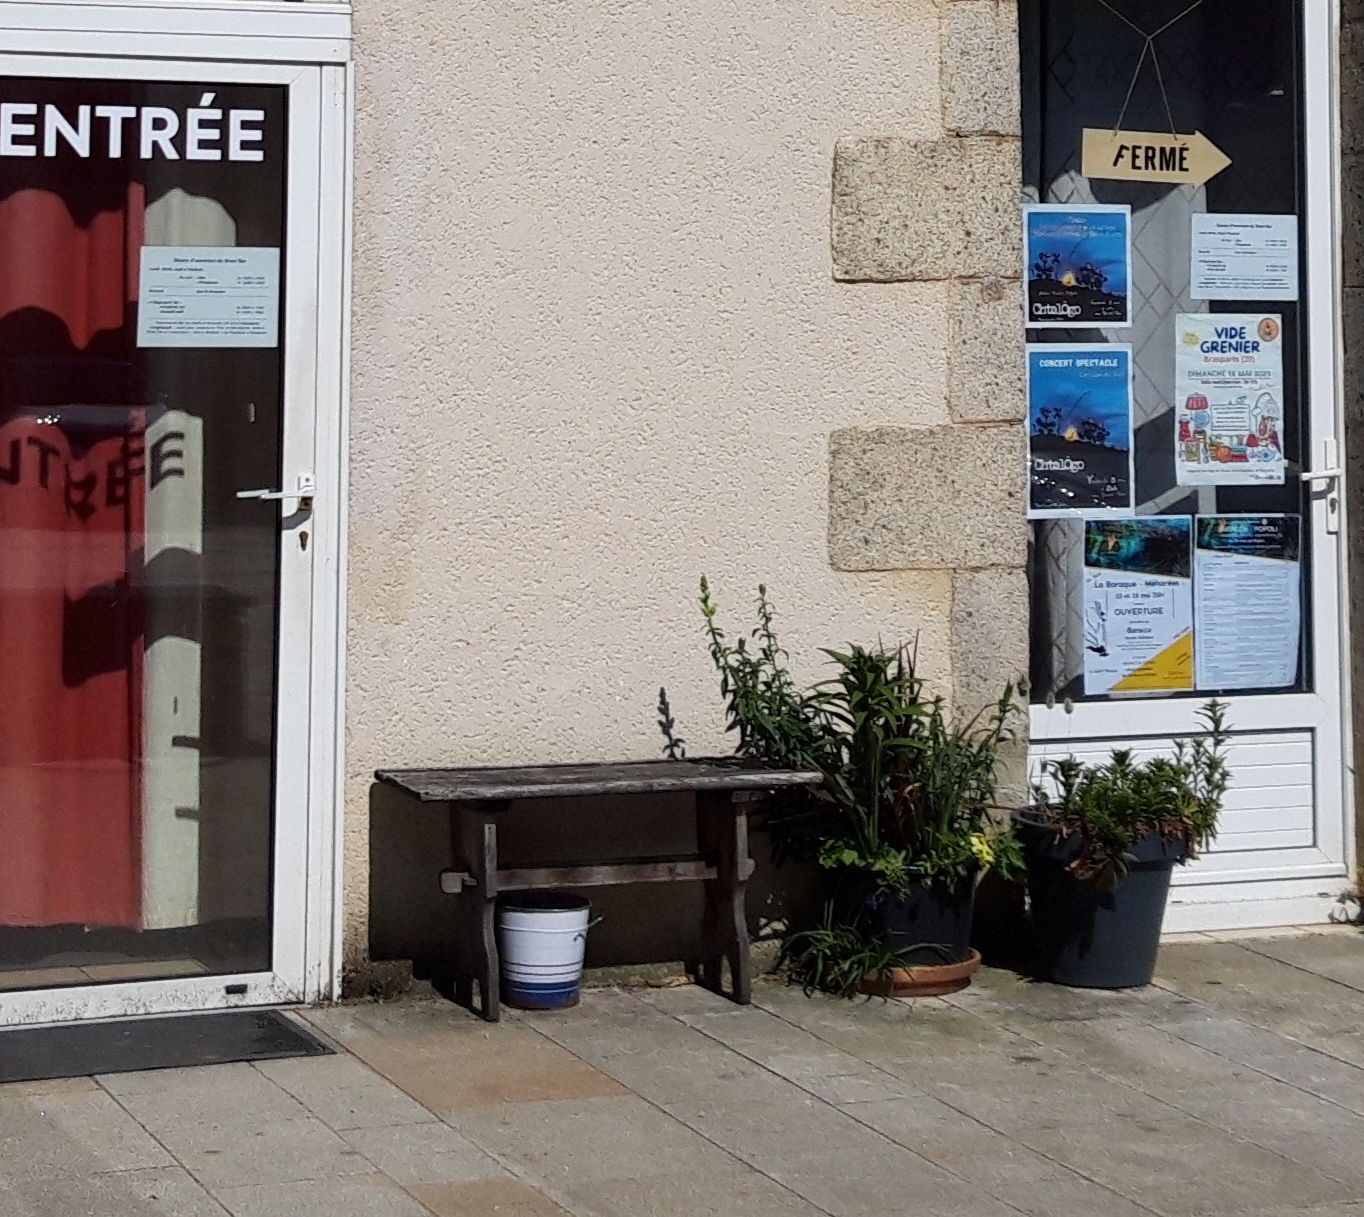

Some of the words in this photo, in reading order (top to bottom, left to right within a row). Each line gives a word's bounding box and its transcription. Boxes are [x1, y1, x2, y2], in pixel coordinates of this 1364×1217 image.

[1112, 142, 1190, 172] FERMÉ
[1214, 326, 1247, 340] VIDE
[1200, 340, 1261, 354] GRENIER
[1039, 358, 1073, 368] CONCERT
[1076, 358, 1118, 368] SPECTACLE
[1187, 370, 1227, 378] DIMANCHE
